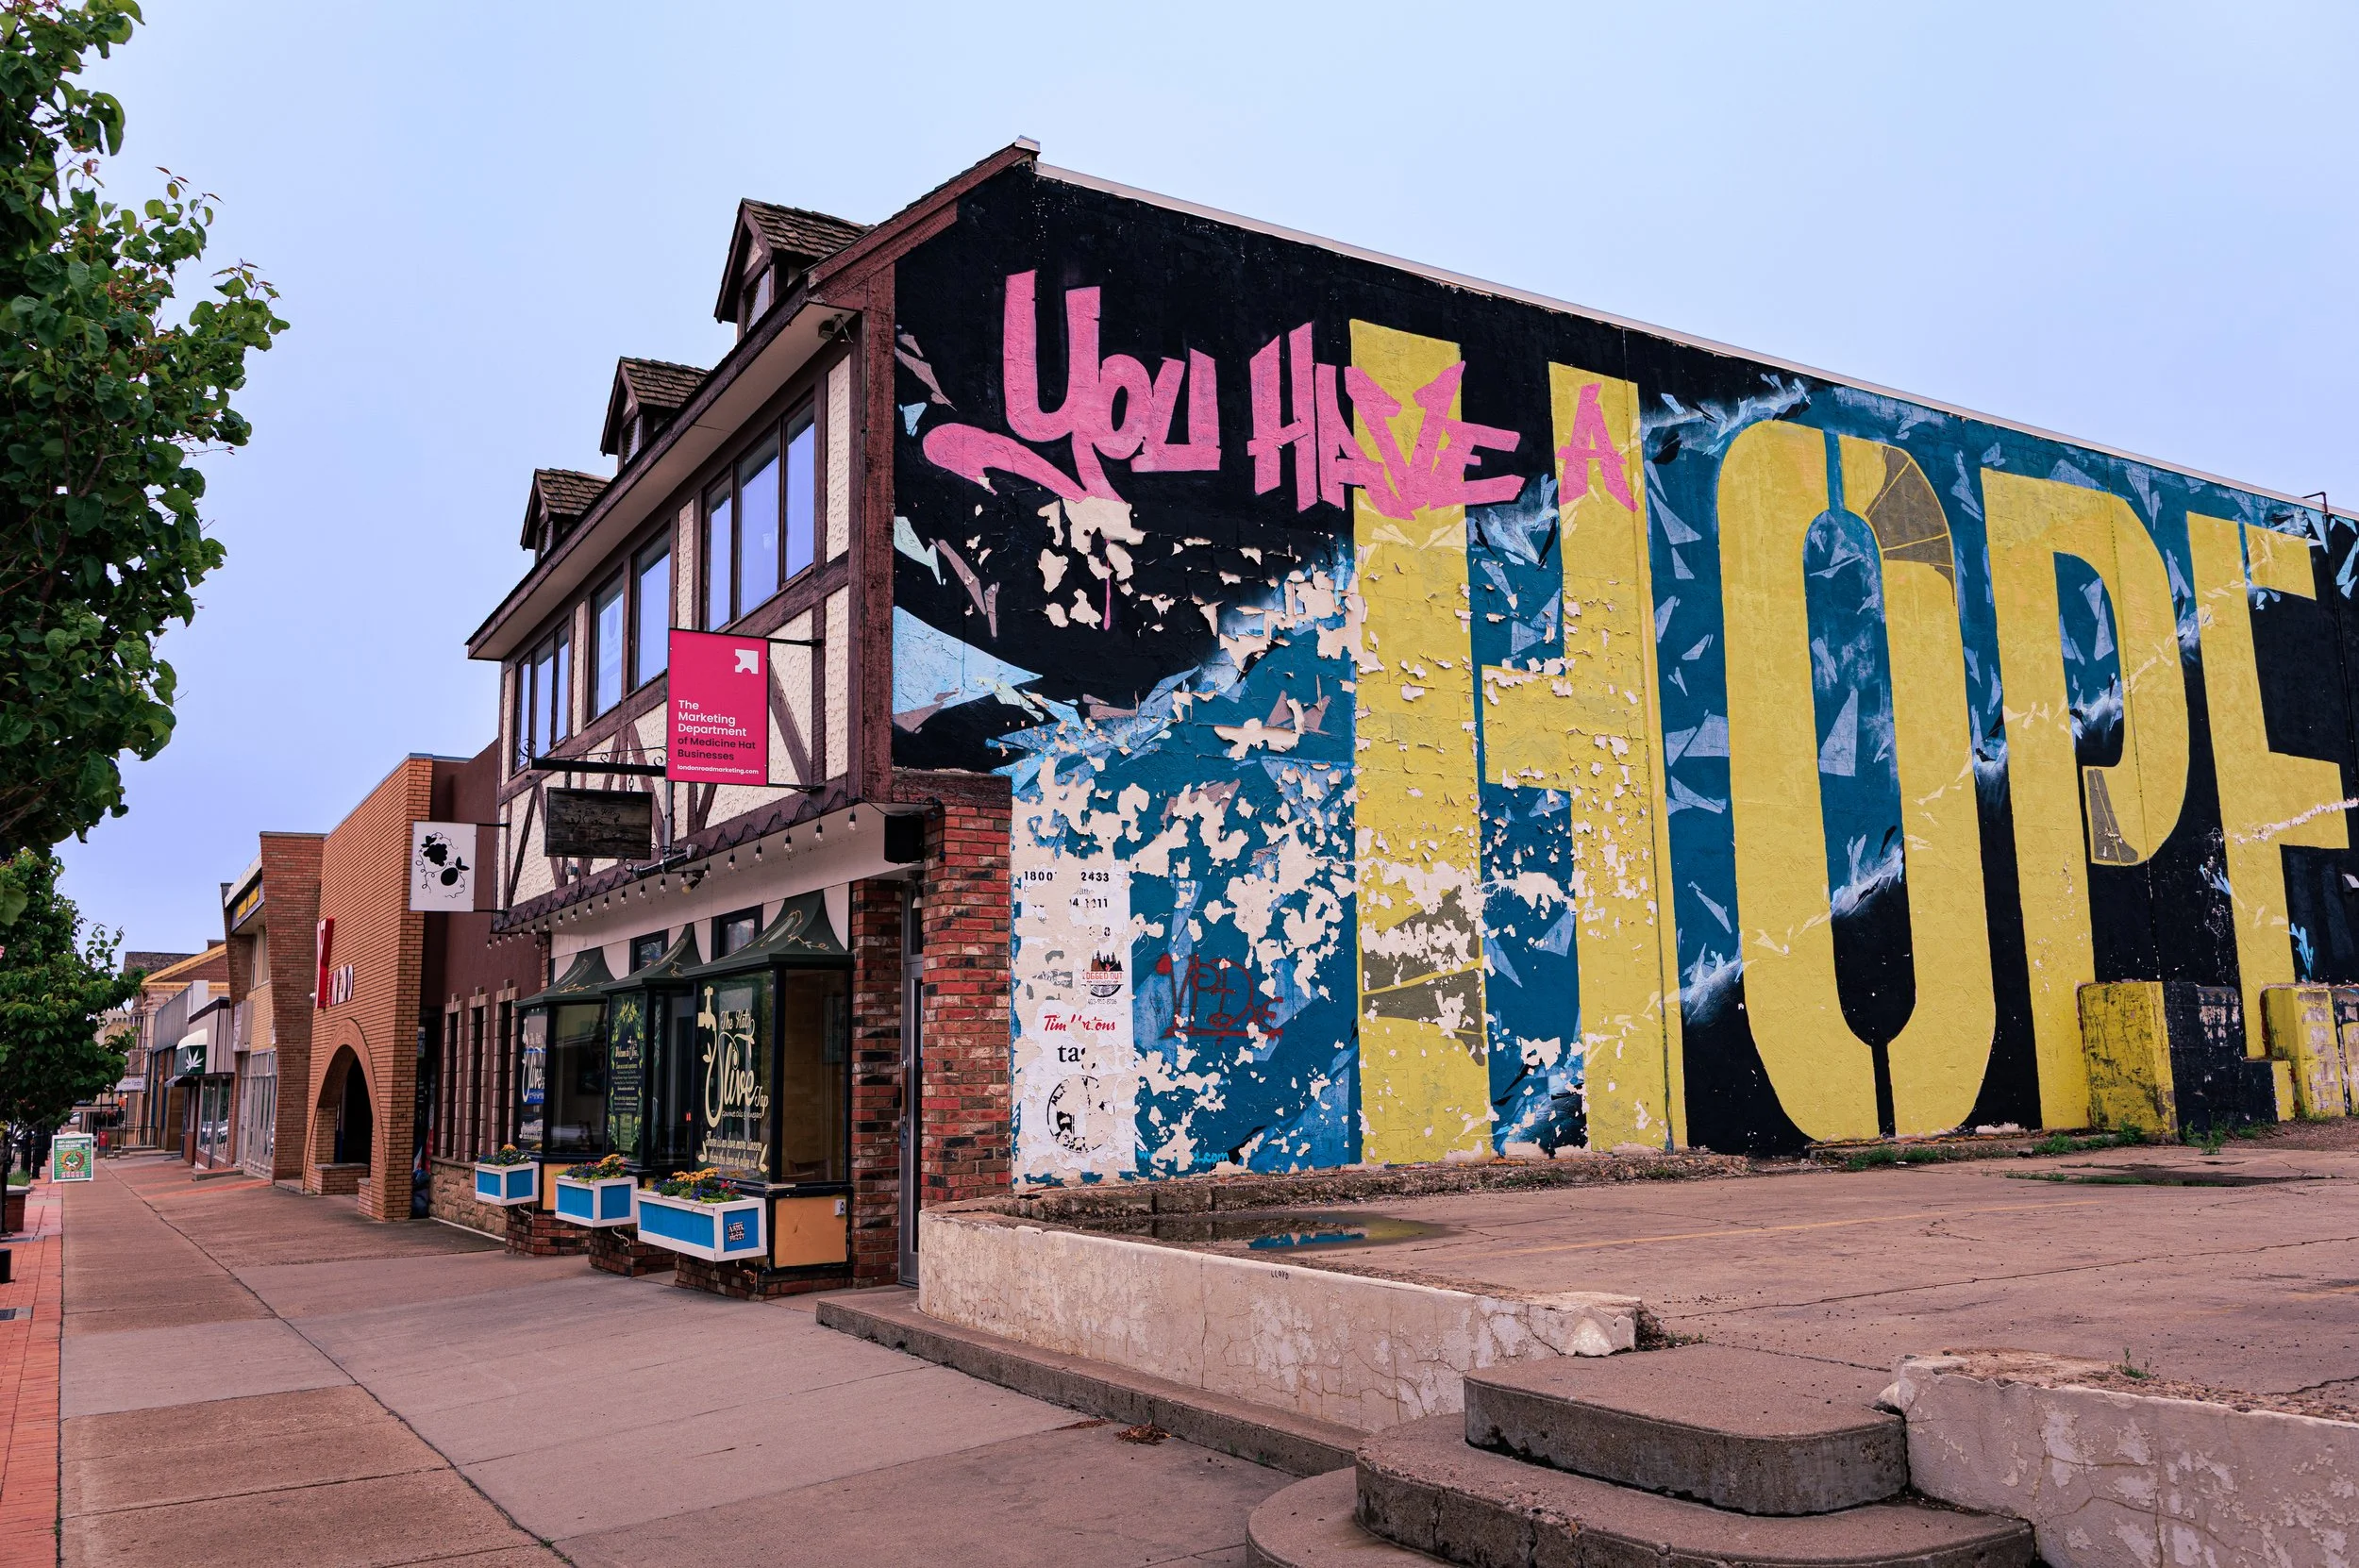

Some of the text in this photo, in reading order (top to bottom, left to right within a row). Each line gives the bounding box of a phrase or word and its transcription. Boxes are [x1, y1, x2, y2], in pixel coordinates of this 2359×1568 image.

[1247, 322, 1526, 520] HAVE
[1558, 383, 1640, 511] A
[678, 700, 699, 709] The
[678, 712, 736, 726] Marketing
[678, 724, 746, 736] Department
[691, 738, 736, 748] Medicine
[739, 741, 756, 749] Hat
[1349, 319, 2359, 1166] HOPE
[678, 749, 734, 760] Businesses
[677, 764, 760, 775] londonroadmarketing.com
[1044, 1014, 1066, 1031] Tim
